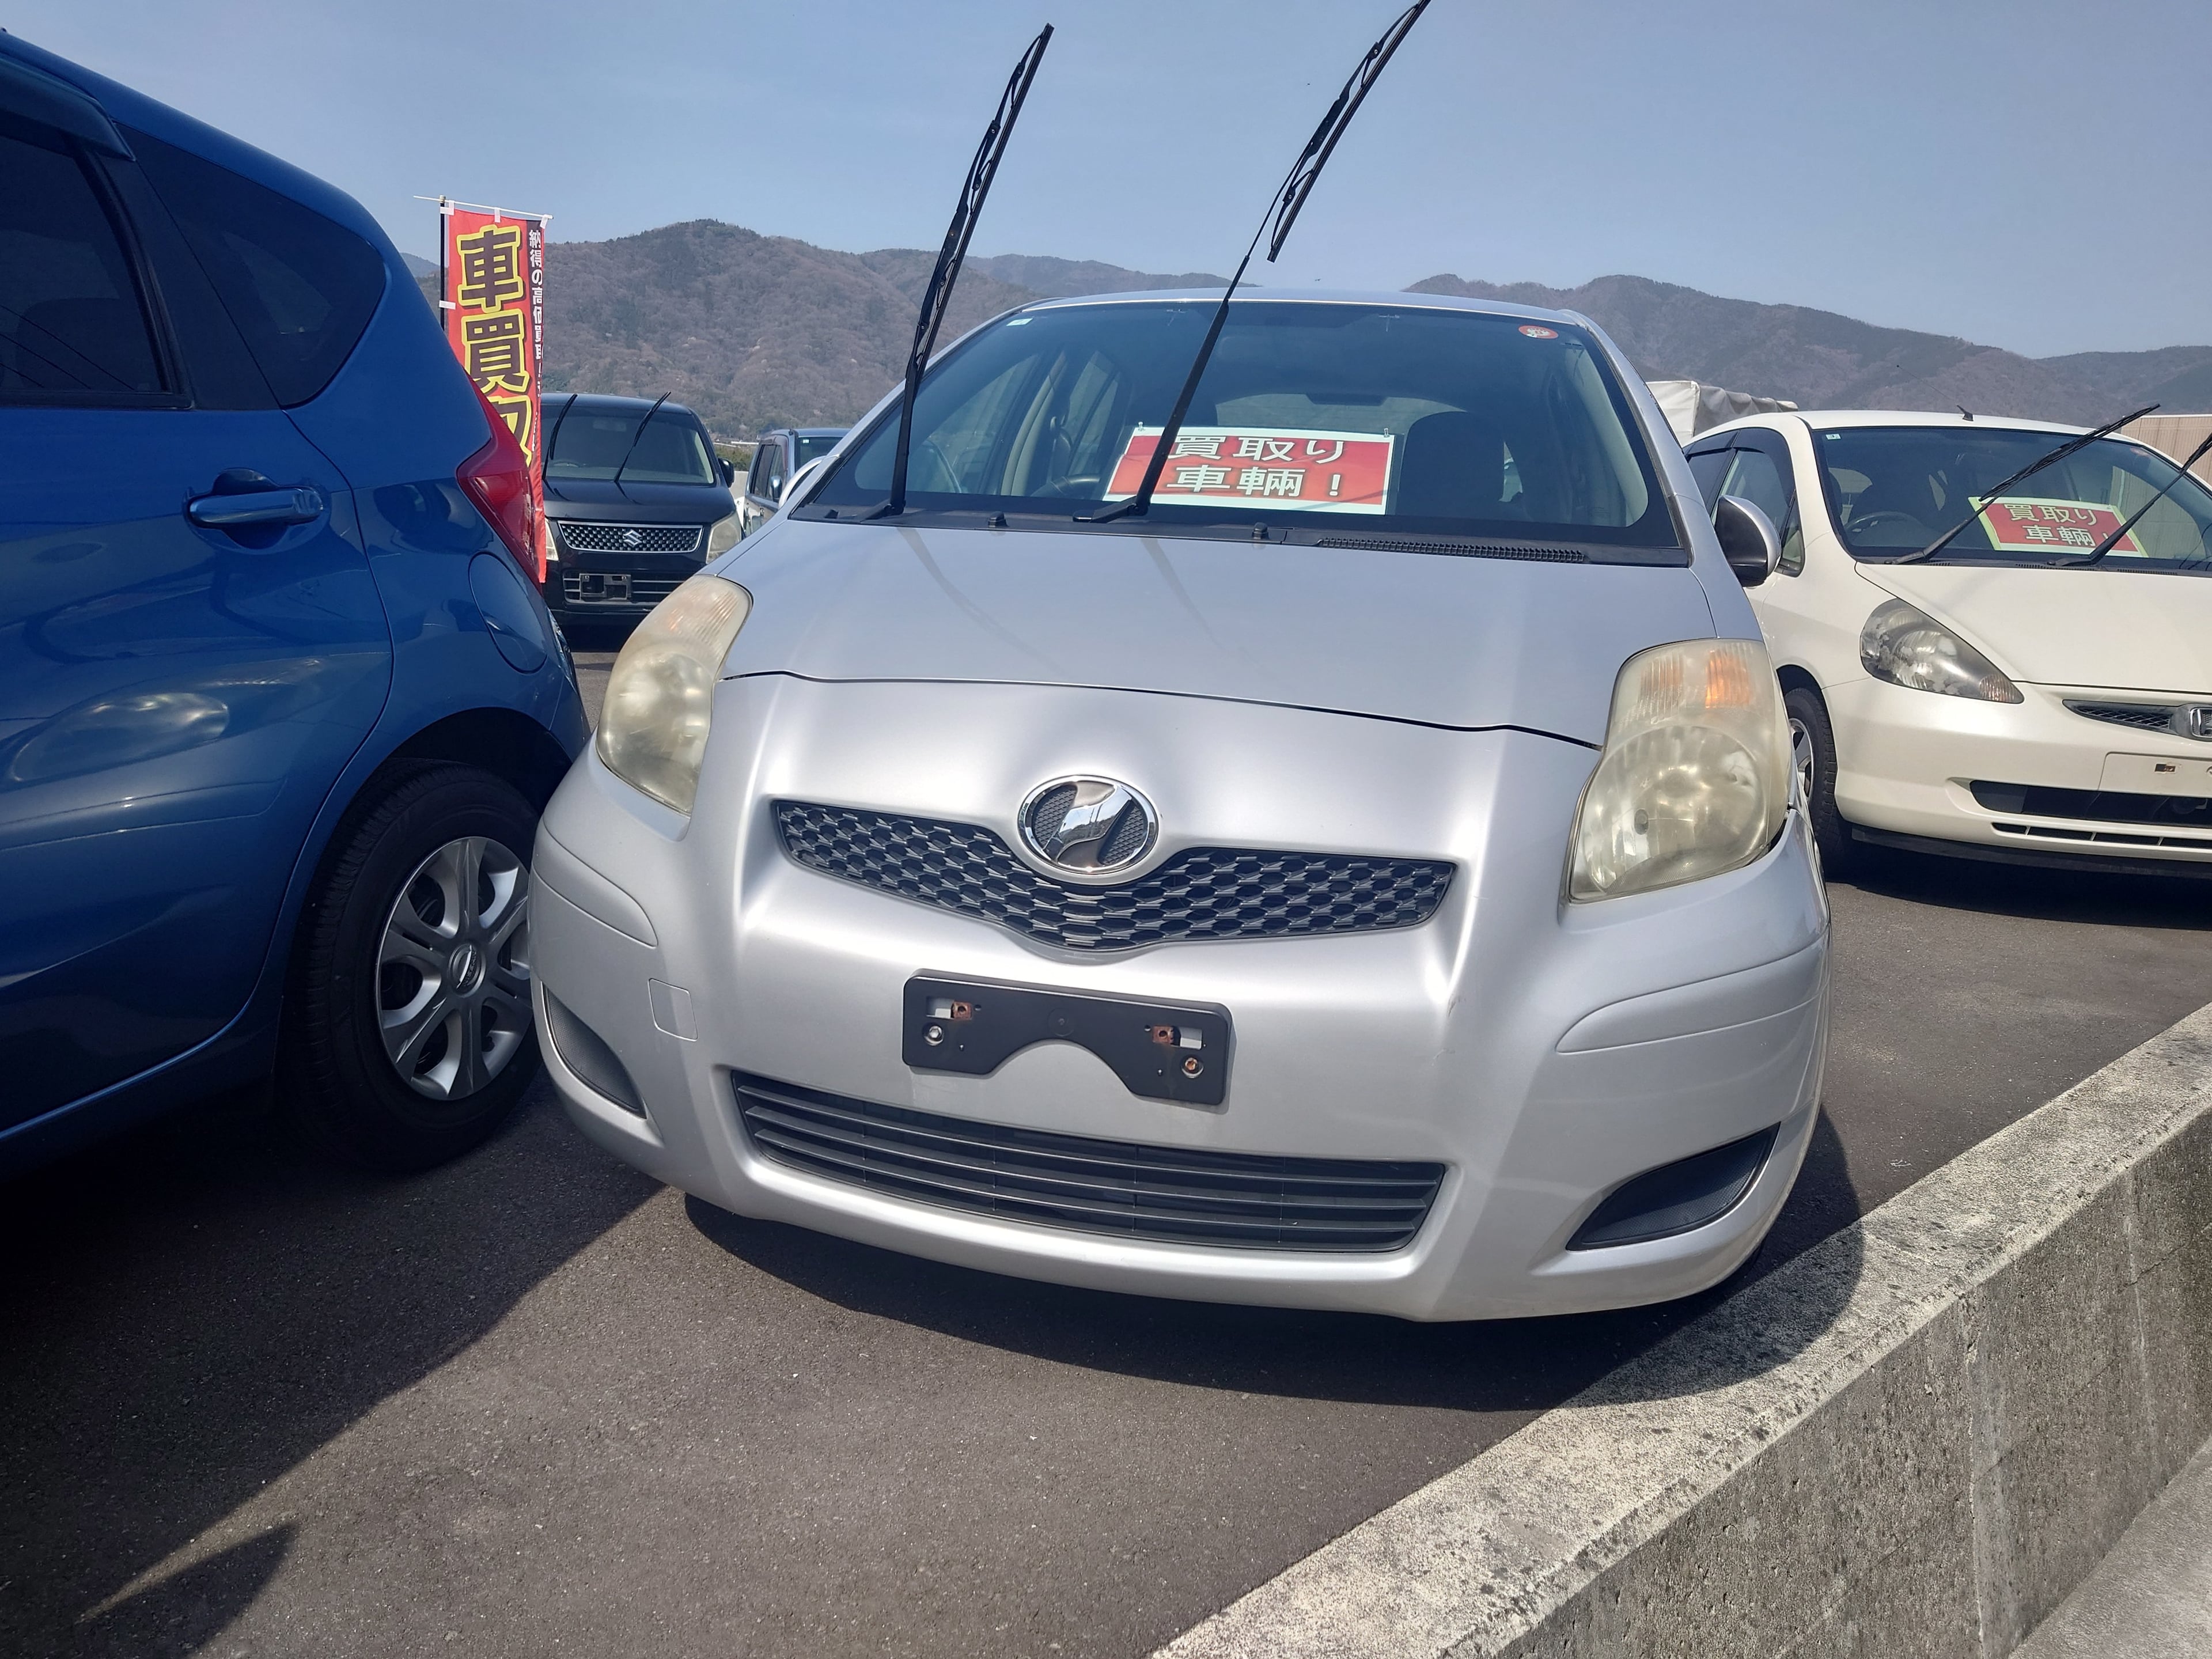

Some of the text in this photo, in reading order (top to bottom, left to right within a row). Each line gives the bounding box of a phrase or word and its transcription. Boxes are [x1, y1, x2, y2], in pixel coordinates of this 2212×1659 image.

[1168, 436, 1344, 464] 買取り
[2004, 503, 2097, 525] 買取り
